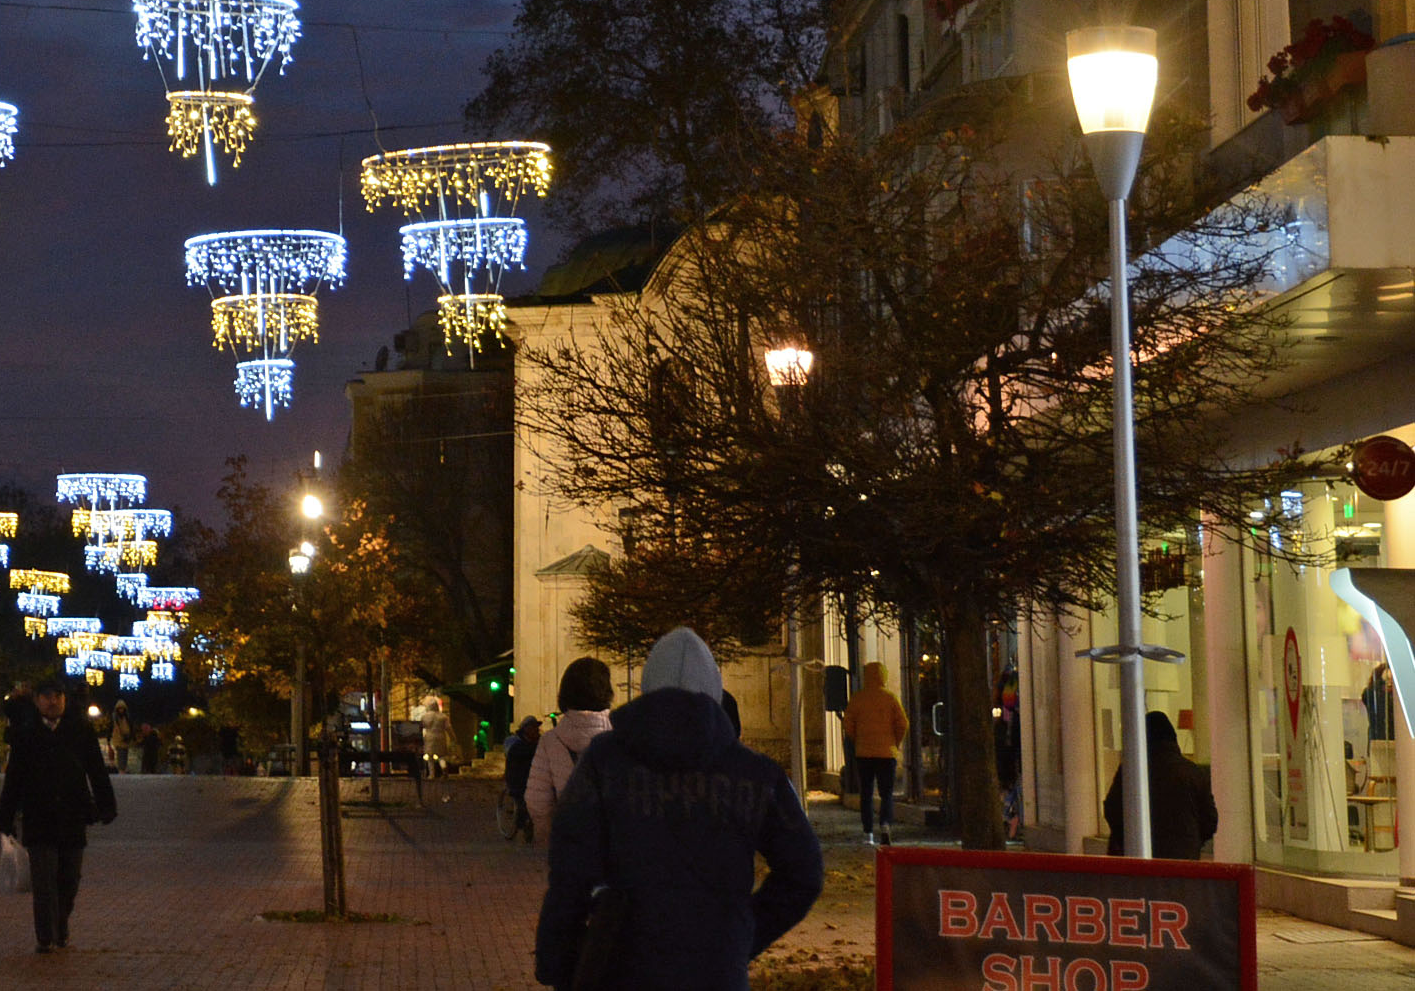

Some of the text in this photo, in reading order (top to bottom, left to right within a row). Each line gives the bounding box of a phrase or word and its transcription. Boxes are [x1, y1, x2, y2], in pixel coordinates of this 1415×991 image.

[1367, 458, 1410, 477] 24/7
[937, 889, 1191, 950] BARBER
[981, 952, 1149, 991] SHOP
